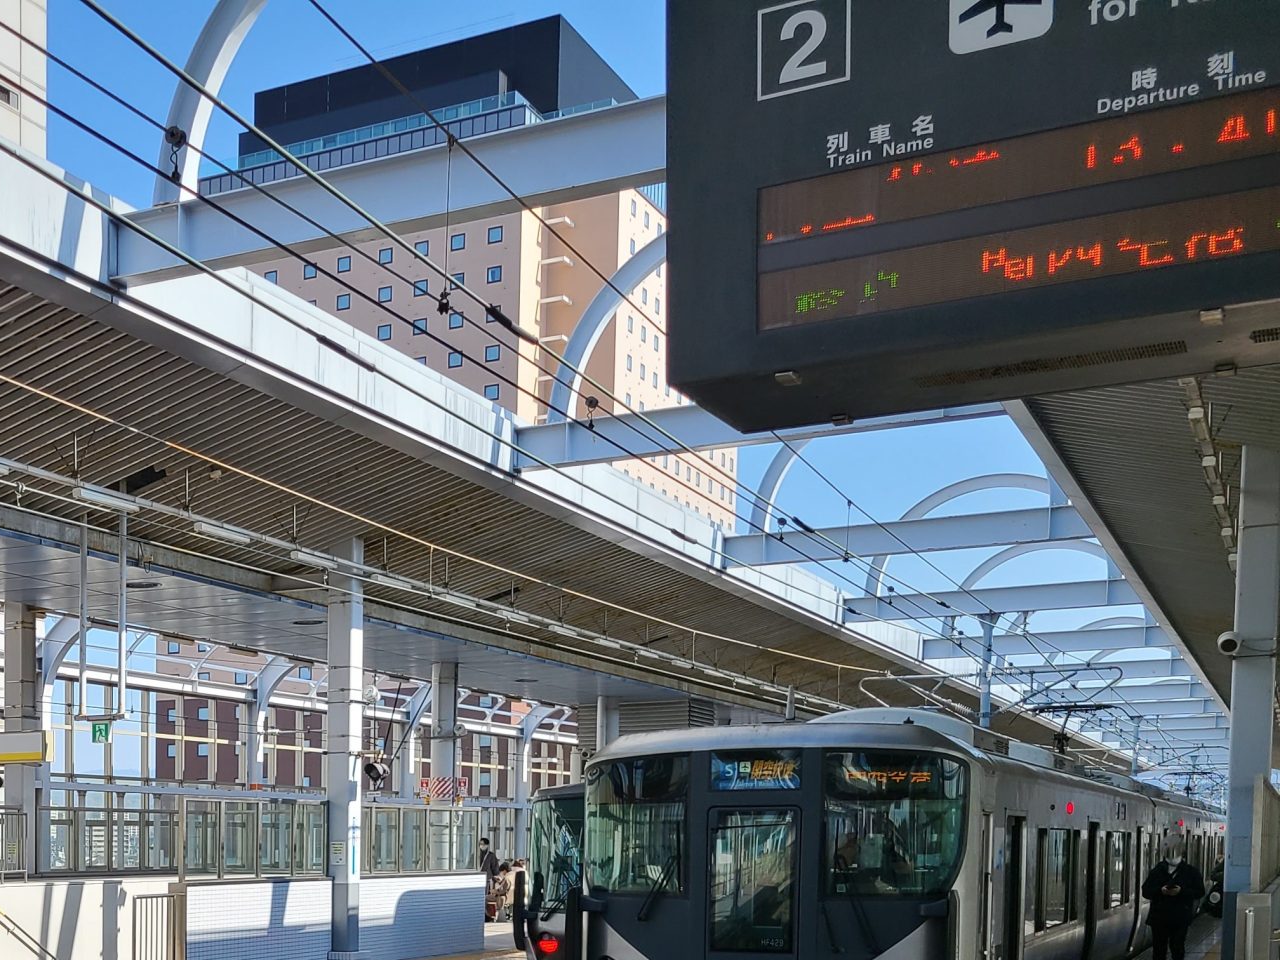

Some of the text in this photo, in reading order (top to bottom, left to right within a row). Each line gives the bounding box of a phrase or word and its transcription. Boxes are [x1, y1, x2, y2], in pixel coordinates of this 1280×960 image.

[1088, 0, 1138, 26] for
[778, 9, 827, 85] 2
[1097, 69, 1267, 114] Departure Time
[826, 148, 872, 168] Train
[882, 136, 935, 157] Name
